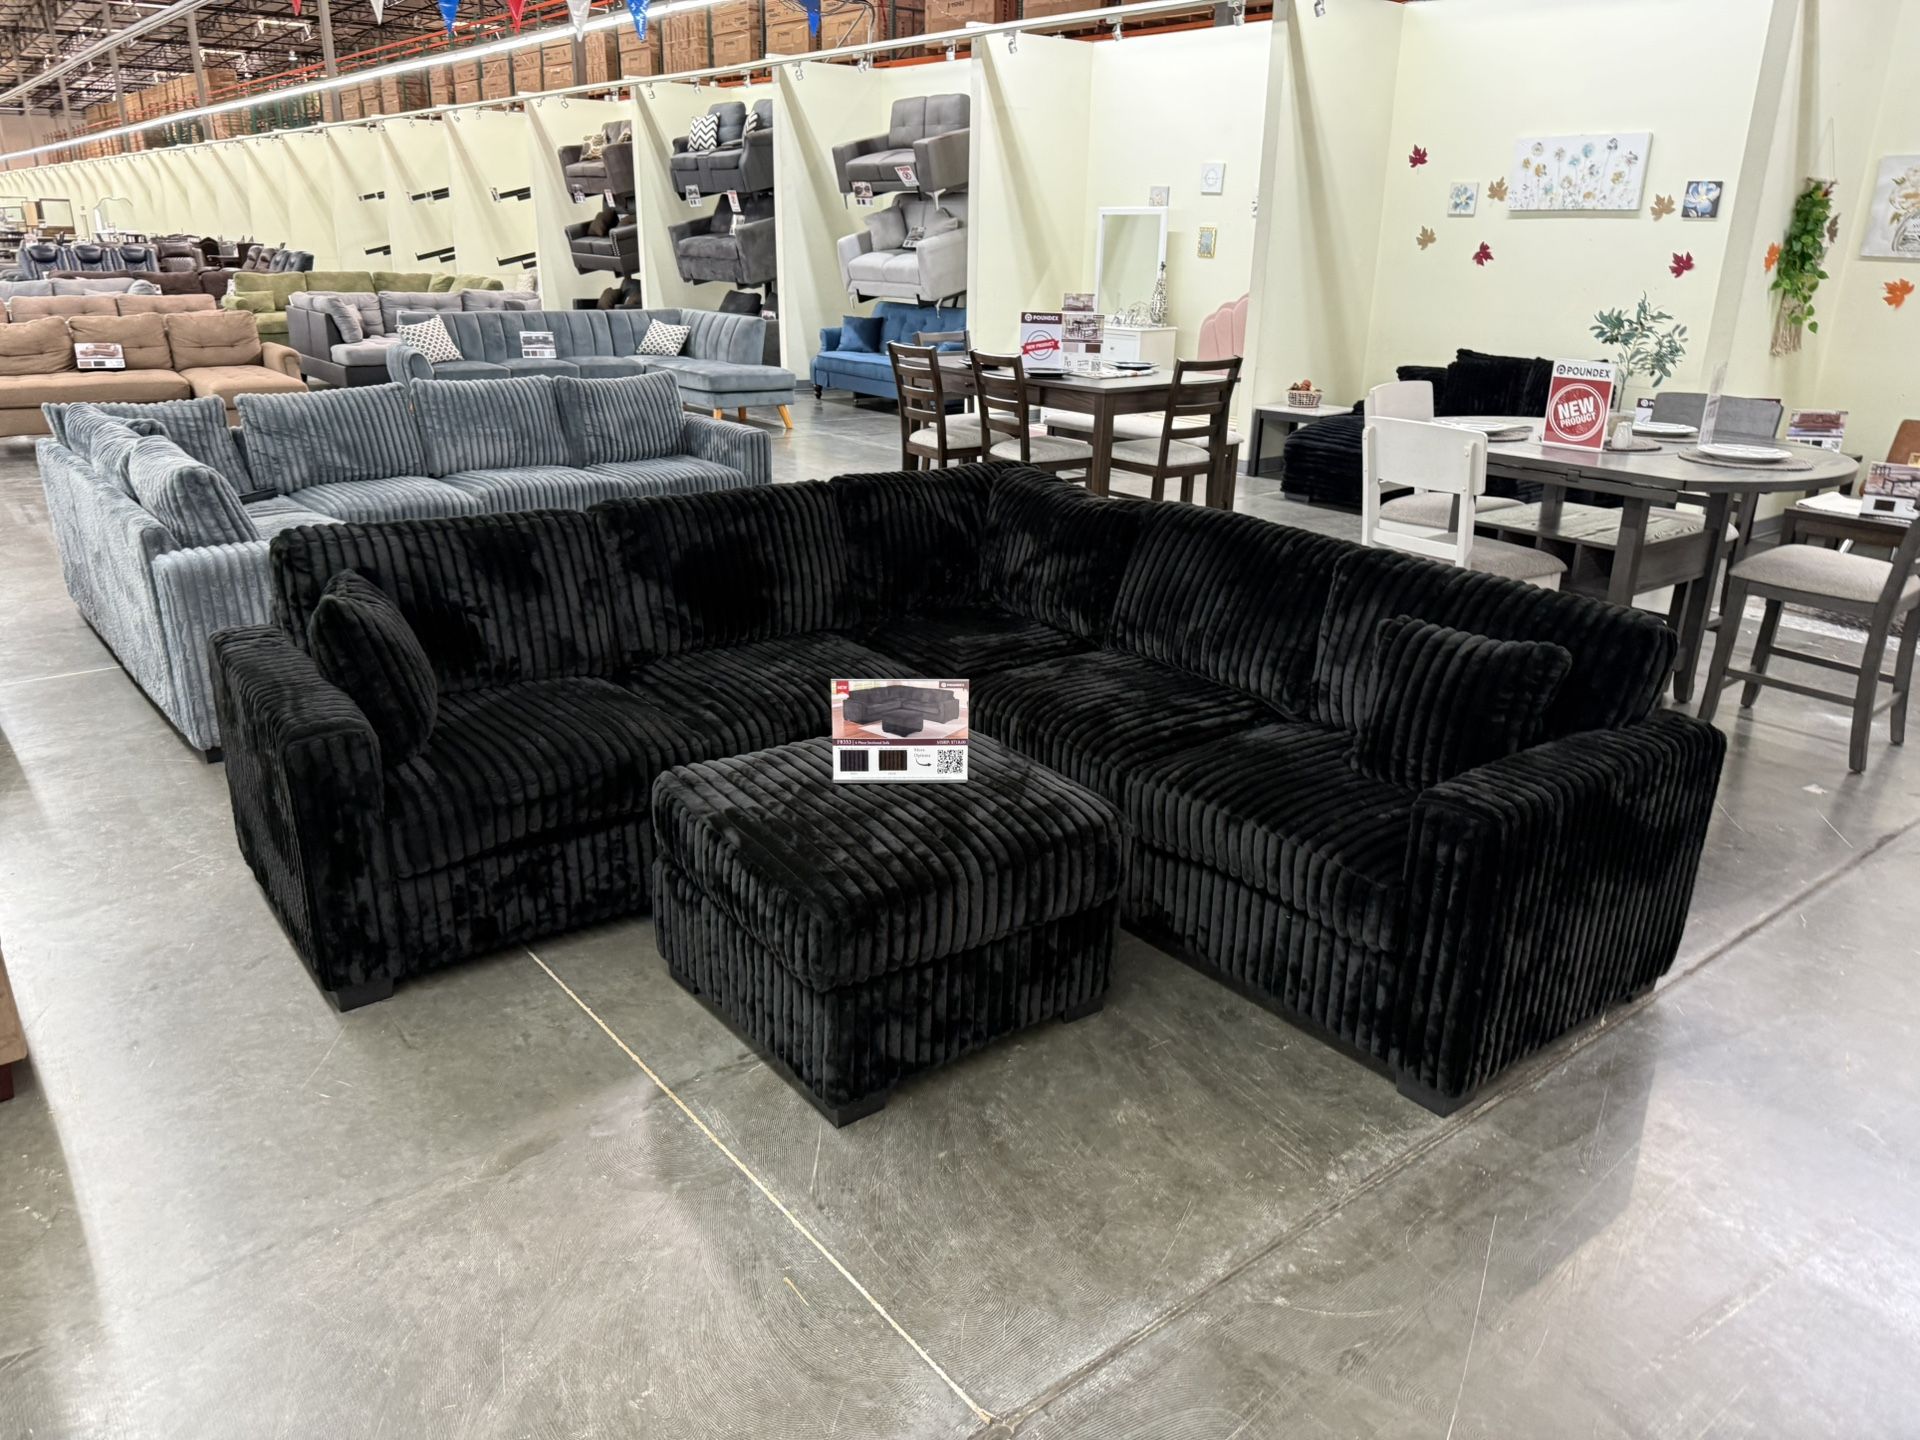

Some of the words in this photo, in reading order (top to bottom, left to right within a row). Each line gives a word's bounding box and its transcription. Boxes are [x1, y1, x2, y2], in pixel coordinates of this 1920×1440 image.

[1033, 313, 1058, 321] POUNDEX
[1566, 366, 1610, 379] POUNDEX
[1557, 396, 1593, 419] NEW
[1560, 412, 1596, 428] PRODUCT
